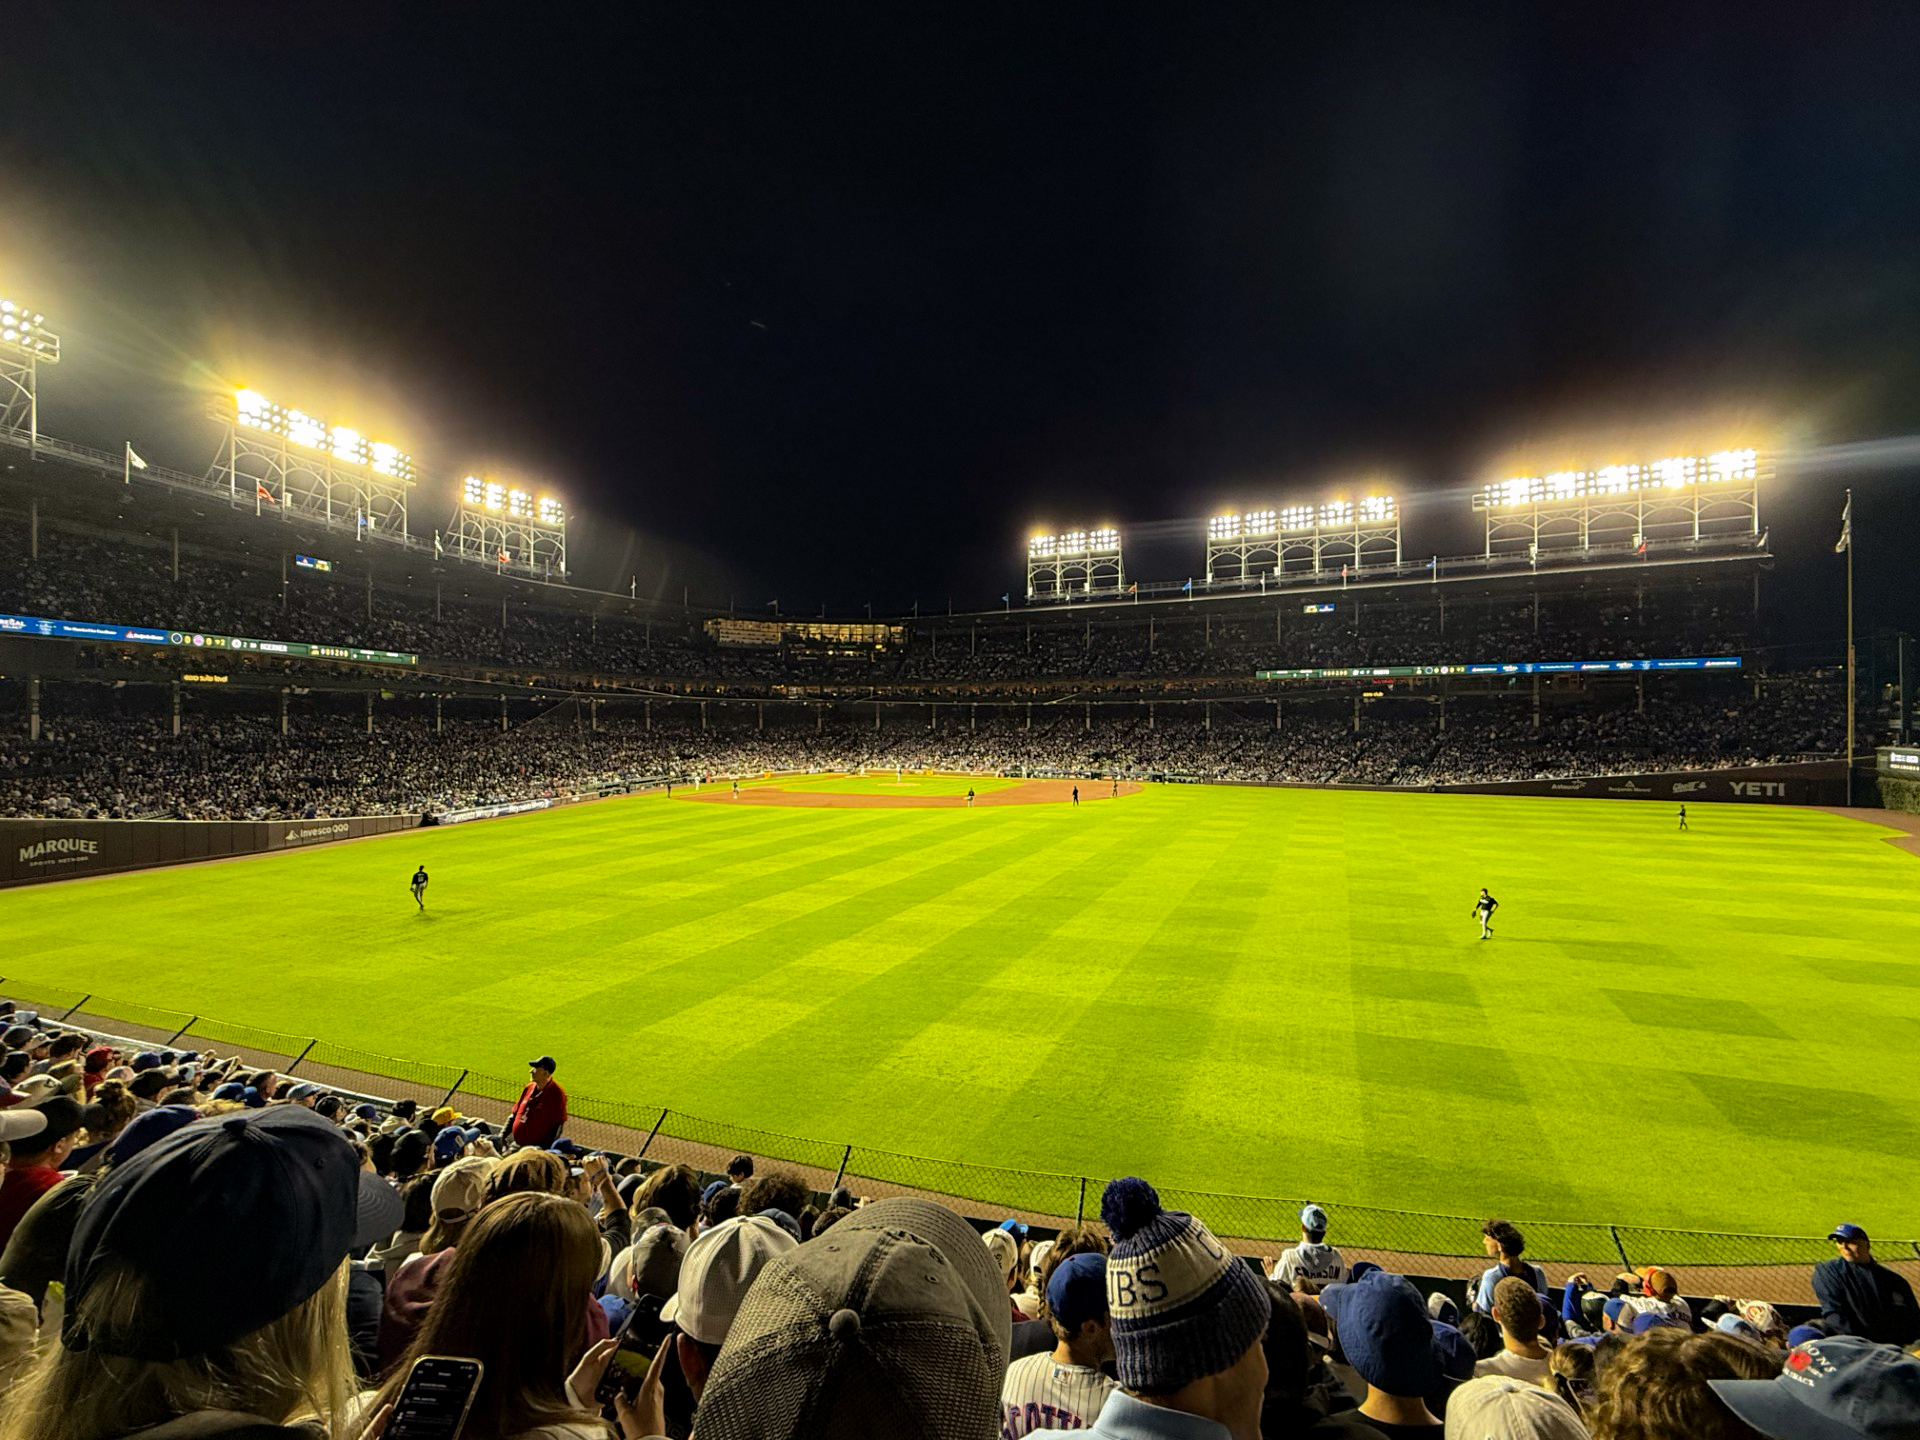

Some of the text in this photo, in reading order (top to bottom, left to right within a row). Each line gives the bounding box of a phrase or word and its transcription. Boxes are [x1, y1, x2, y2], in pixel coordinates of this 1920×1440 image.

[1729, 781, 1785, 796] YETI
[300, 826, 331, 838] Invesco
[19, 838, 98, 862] MARQUEE
